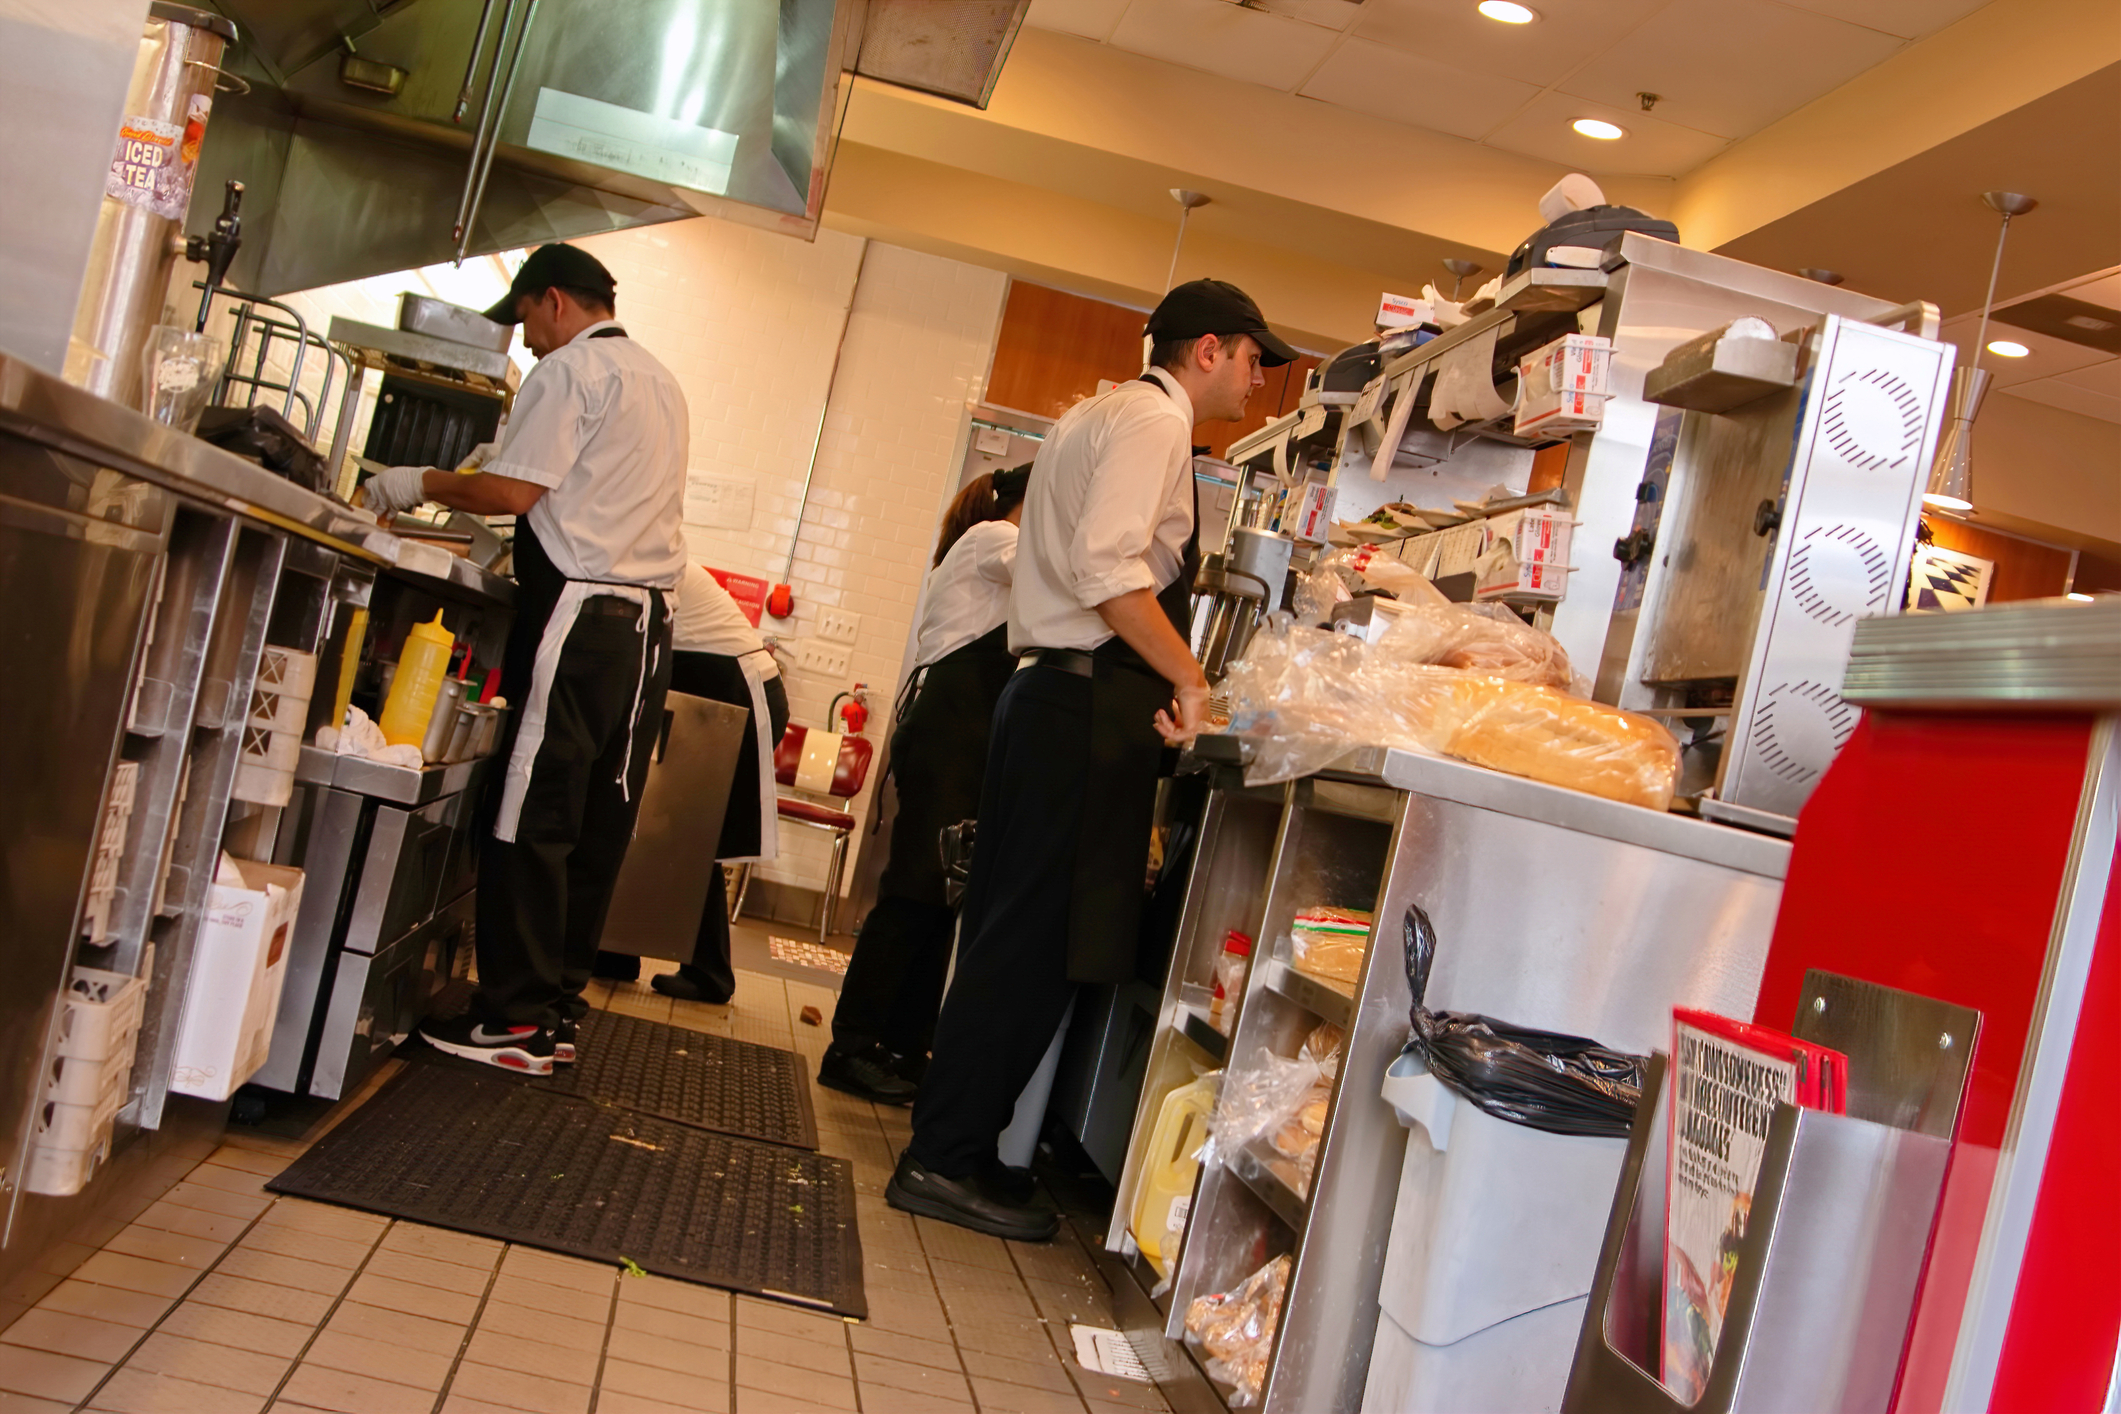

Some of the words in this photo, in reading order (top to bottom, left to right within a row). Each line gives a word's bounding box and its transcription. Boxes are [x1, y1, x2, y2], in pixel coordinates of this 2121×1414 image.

[125, 140, 163, 168] ICED
[125, 164, 156, 190] TEA
[732, 578, 760, 589] WARNING
